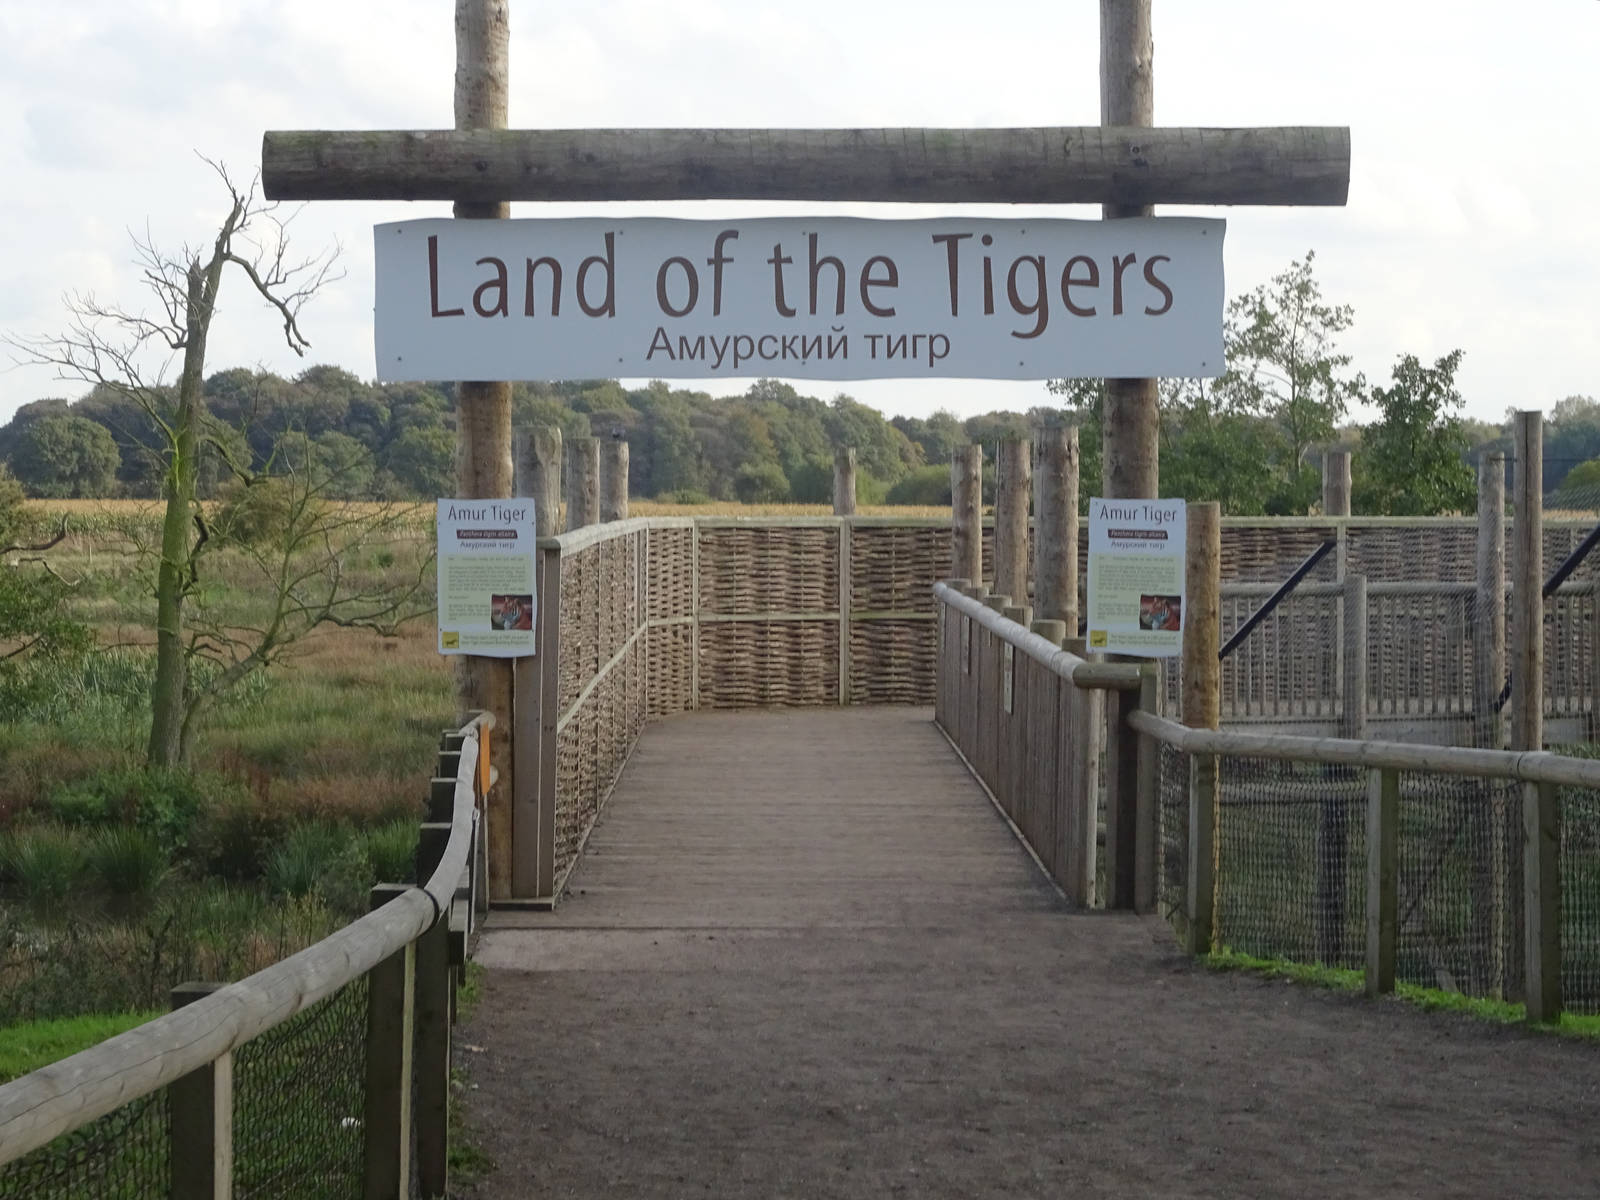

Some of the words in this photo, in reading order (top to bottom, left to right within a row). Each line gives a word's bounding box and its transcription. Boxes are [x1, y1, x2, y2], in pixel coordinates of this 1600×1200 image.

[428, 232, 615, 318] Land
[656, 229, 739, 318] of
[767, 233, 898, 317] the
[932, 233, 1173, 338] Tigers
[646, 325, 848, 369] Амурский
[864, 333, 951, 368] тигр
[448, 505, 487, 521] Amur
[490, 505, 526, 525] Tiger
[1100, 504, 1138, 521] Amur
[1142, 505, 1178, 525] Tiger
